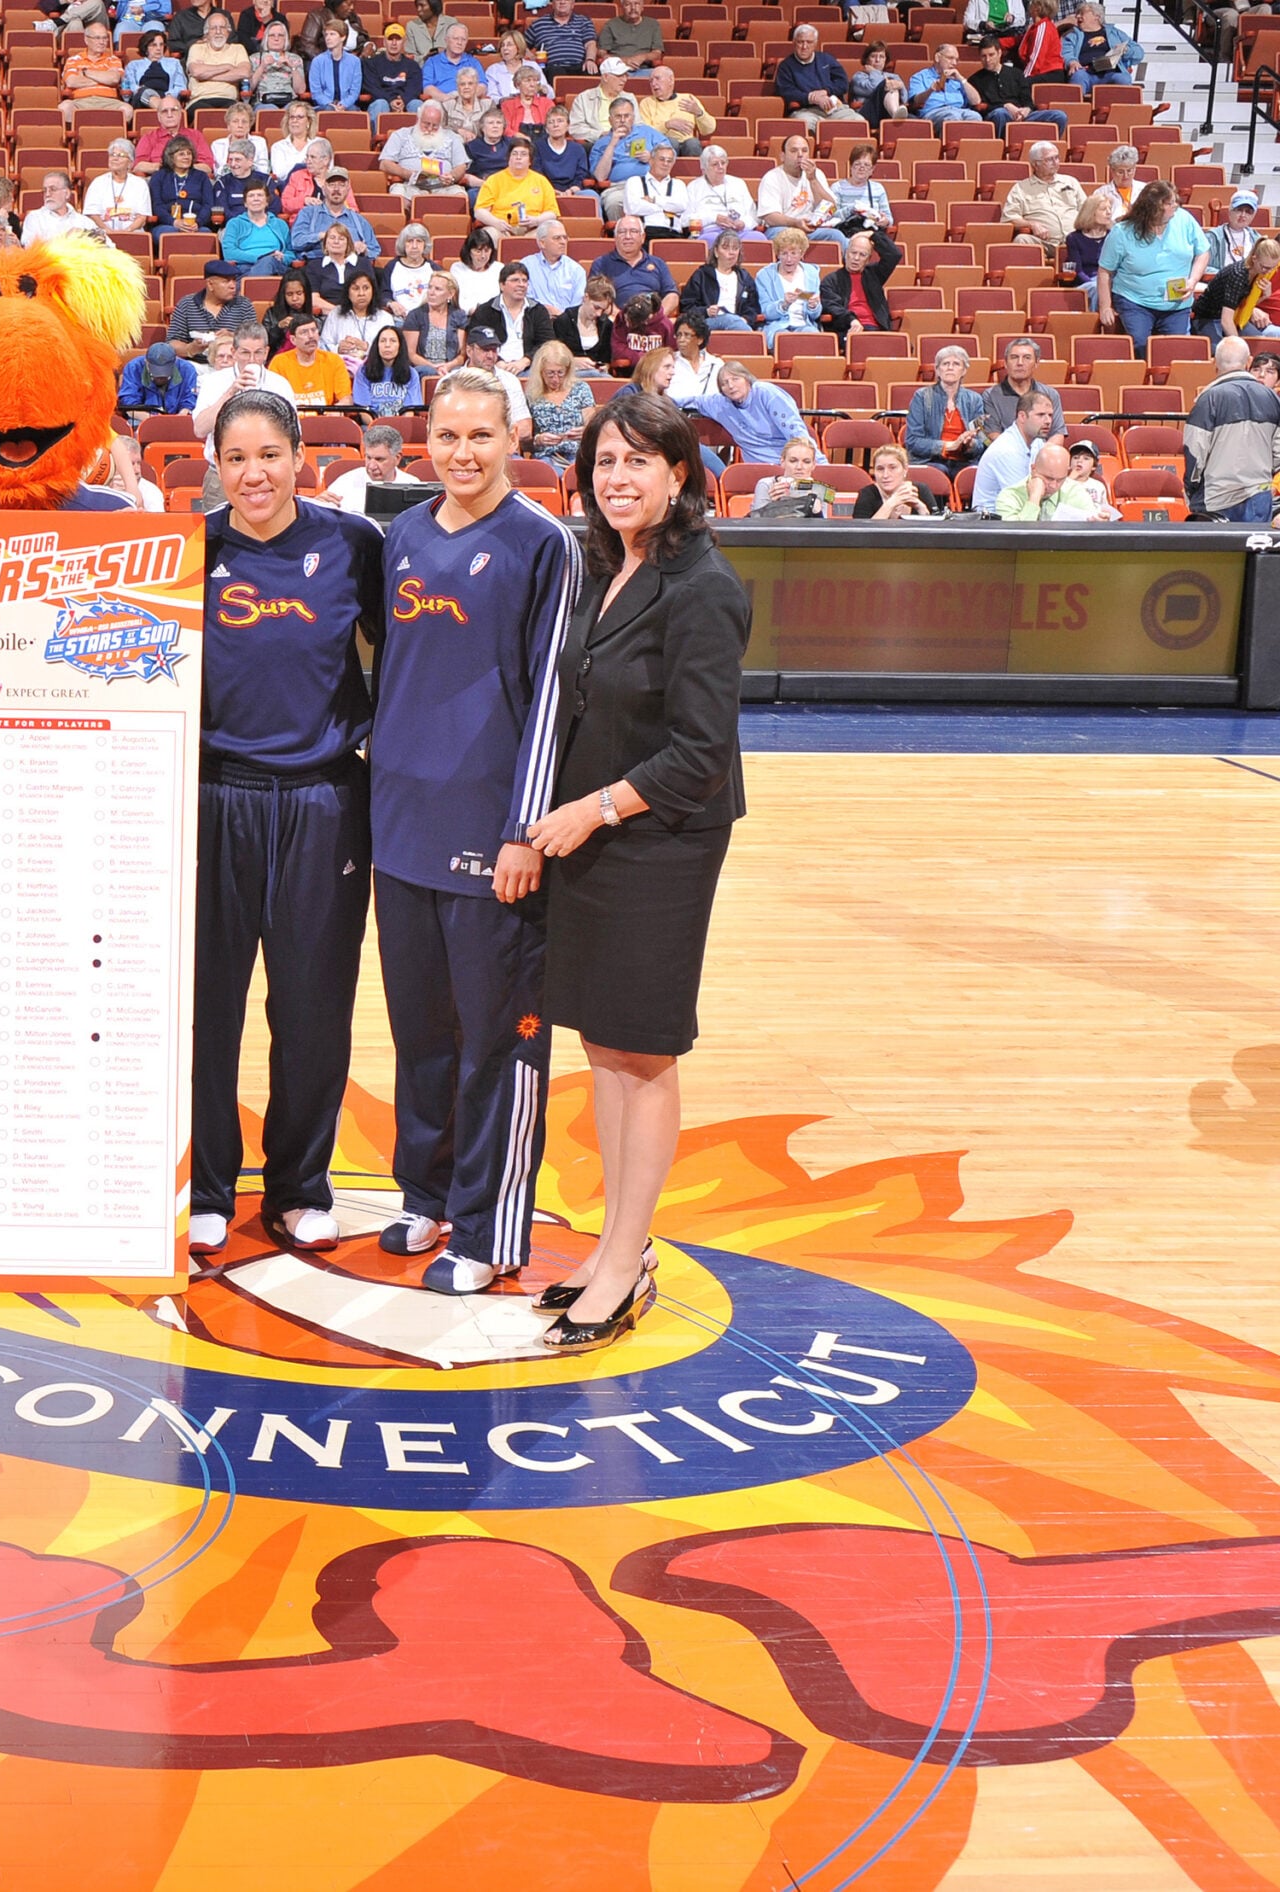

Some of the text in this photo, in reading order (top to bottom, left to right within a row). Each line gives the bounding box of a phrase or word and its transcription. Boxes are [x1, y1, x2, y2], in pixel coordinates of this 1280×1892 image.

[11, 535, 55, 554] YOUR
[66, 558, 84, 573] AT
[94, 537, 182, 588] SUN
[60, 571, 84, 587] THE
[216, 582, 317, 629] Sun
[392, 576, 469, 624] Sun
[770, 579, 1091, 631] MOTORCYCLES
[49, 643, 65, 653] THE
[64, 630, 123, 656] STARS
[138, 623, 175, 646] SUN
[96, 650, 130, 661] 2010
[6, 688, 48, 698] EXPECT
[460, 862, 469, 870] LT
